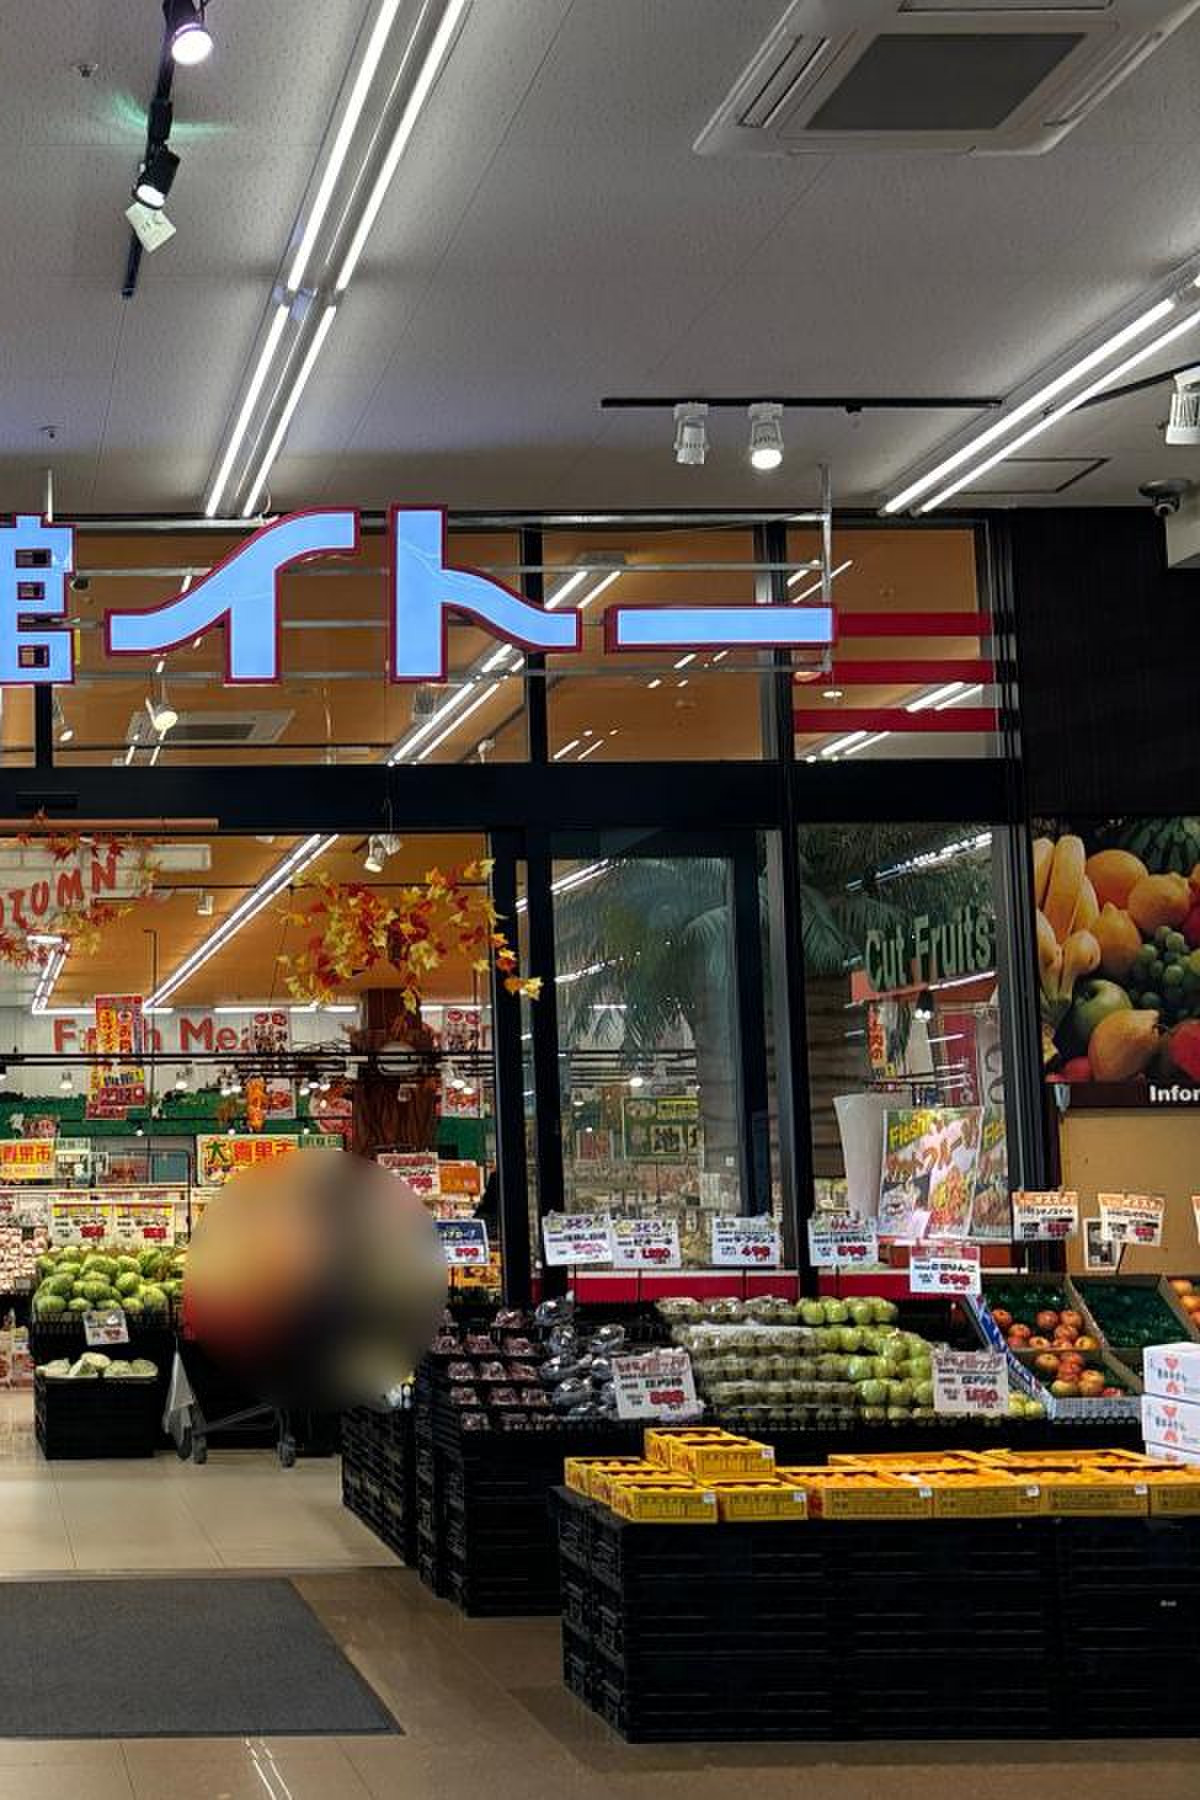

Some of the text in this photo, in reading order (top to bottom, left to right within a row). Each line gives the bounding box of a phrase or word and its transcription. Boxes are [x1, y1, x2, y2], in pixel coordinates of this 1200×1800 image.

[865, 902, 993, 992] Cut Fruits
[1149, 1084, 1200, 1102] Infor
